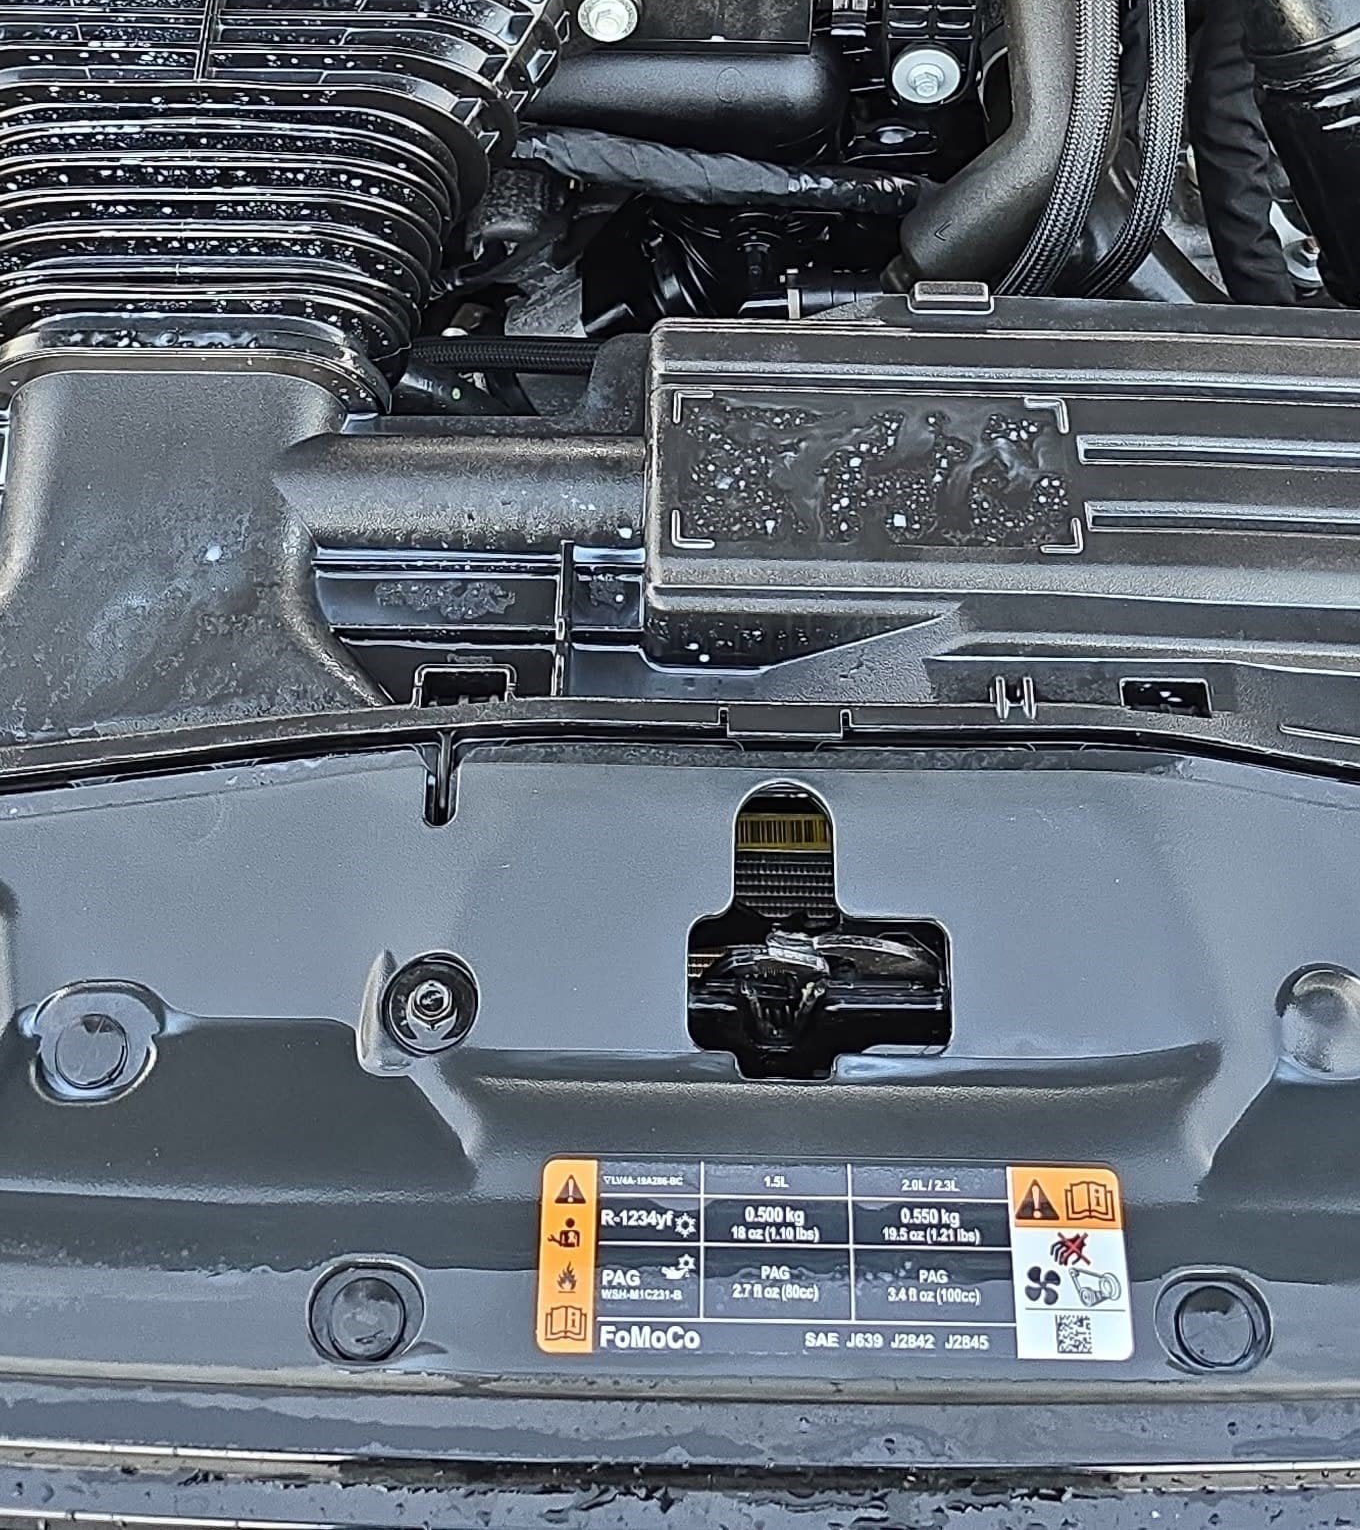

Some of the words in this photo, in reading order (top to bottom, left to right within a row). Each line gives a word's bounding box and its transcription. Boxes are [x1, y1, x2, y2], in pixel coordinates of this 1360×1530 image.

[763, 1175, 789, 1188] 1.5L
[901, 1179, 926, 1192] 2.0L
[934, 1179, 961, 1192] 2.3L
[600, 1209, 674, 1231] R-1234yf
[744, 1206, 784, 1223] 0.500
[785, 1207, 805, 1227] kg
[900, 1208, 939, 1224] 0.550
[941, 1209, 960, 1228] kg
[730, 1226, 746, 1239] 18
[748, 1229, 764, 1239] oz
[765, 1227, 794, 1242] (1.10
[796, 1227, 820, 1242] lbs)
[881, 1227, 908, 1241] 19.5
[909, 1230, 925, 1241] oz
[926, 1228, 955, 1244] (1.21
[957, 1228, 981, 1245] lbs)
[601, 1270, 641, 1286] PAG
[760, 1266, 791, 1280] PAG
[919, 1270, 949, 1284] PAG
[601, 1288, 683, 1301] WSH-M1C231-B
[731, 1284, 751, 1299] 2.7
[753, 1284, 763, 1299] fl
[764, 1287, 780, 1300] oz
[887, 1287, 907, 1302] 3.4
[909, 1287, 918, 1302] fl
[919, 1290, 935, 1303] oz
[936, 1288, 982, 1306] (100cc)
[599, 1325, 701, 1349] FoMoCo
[804, 1332, 840, 1348] SAE
[846, 1332, 884, 1348] J639
[890, 1333, 936, 1349] J2842
[944, 1334, 990, 1350] J2845
